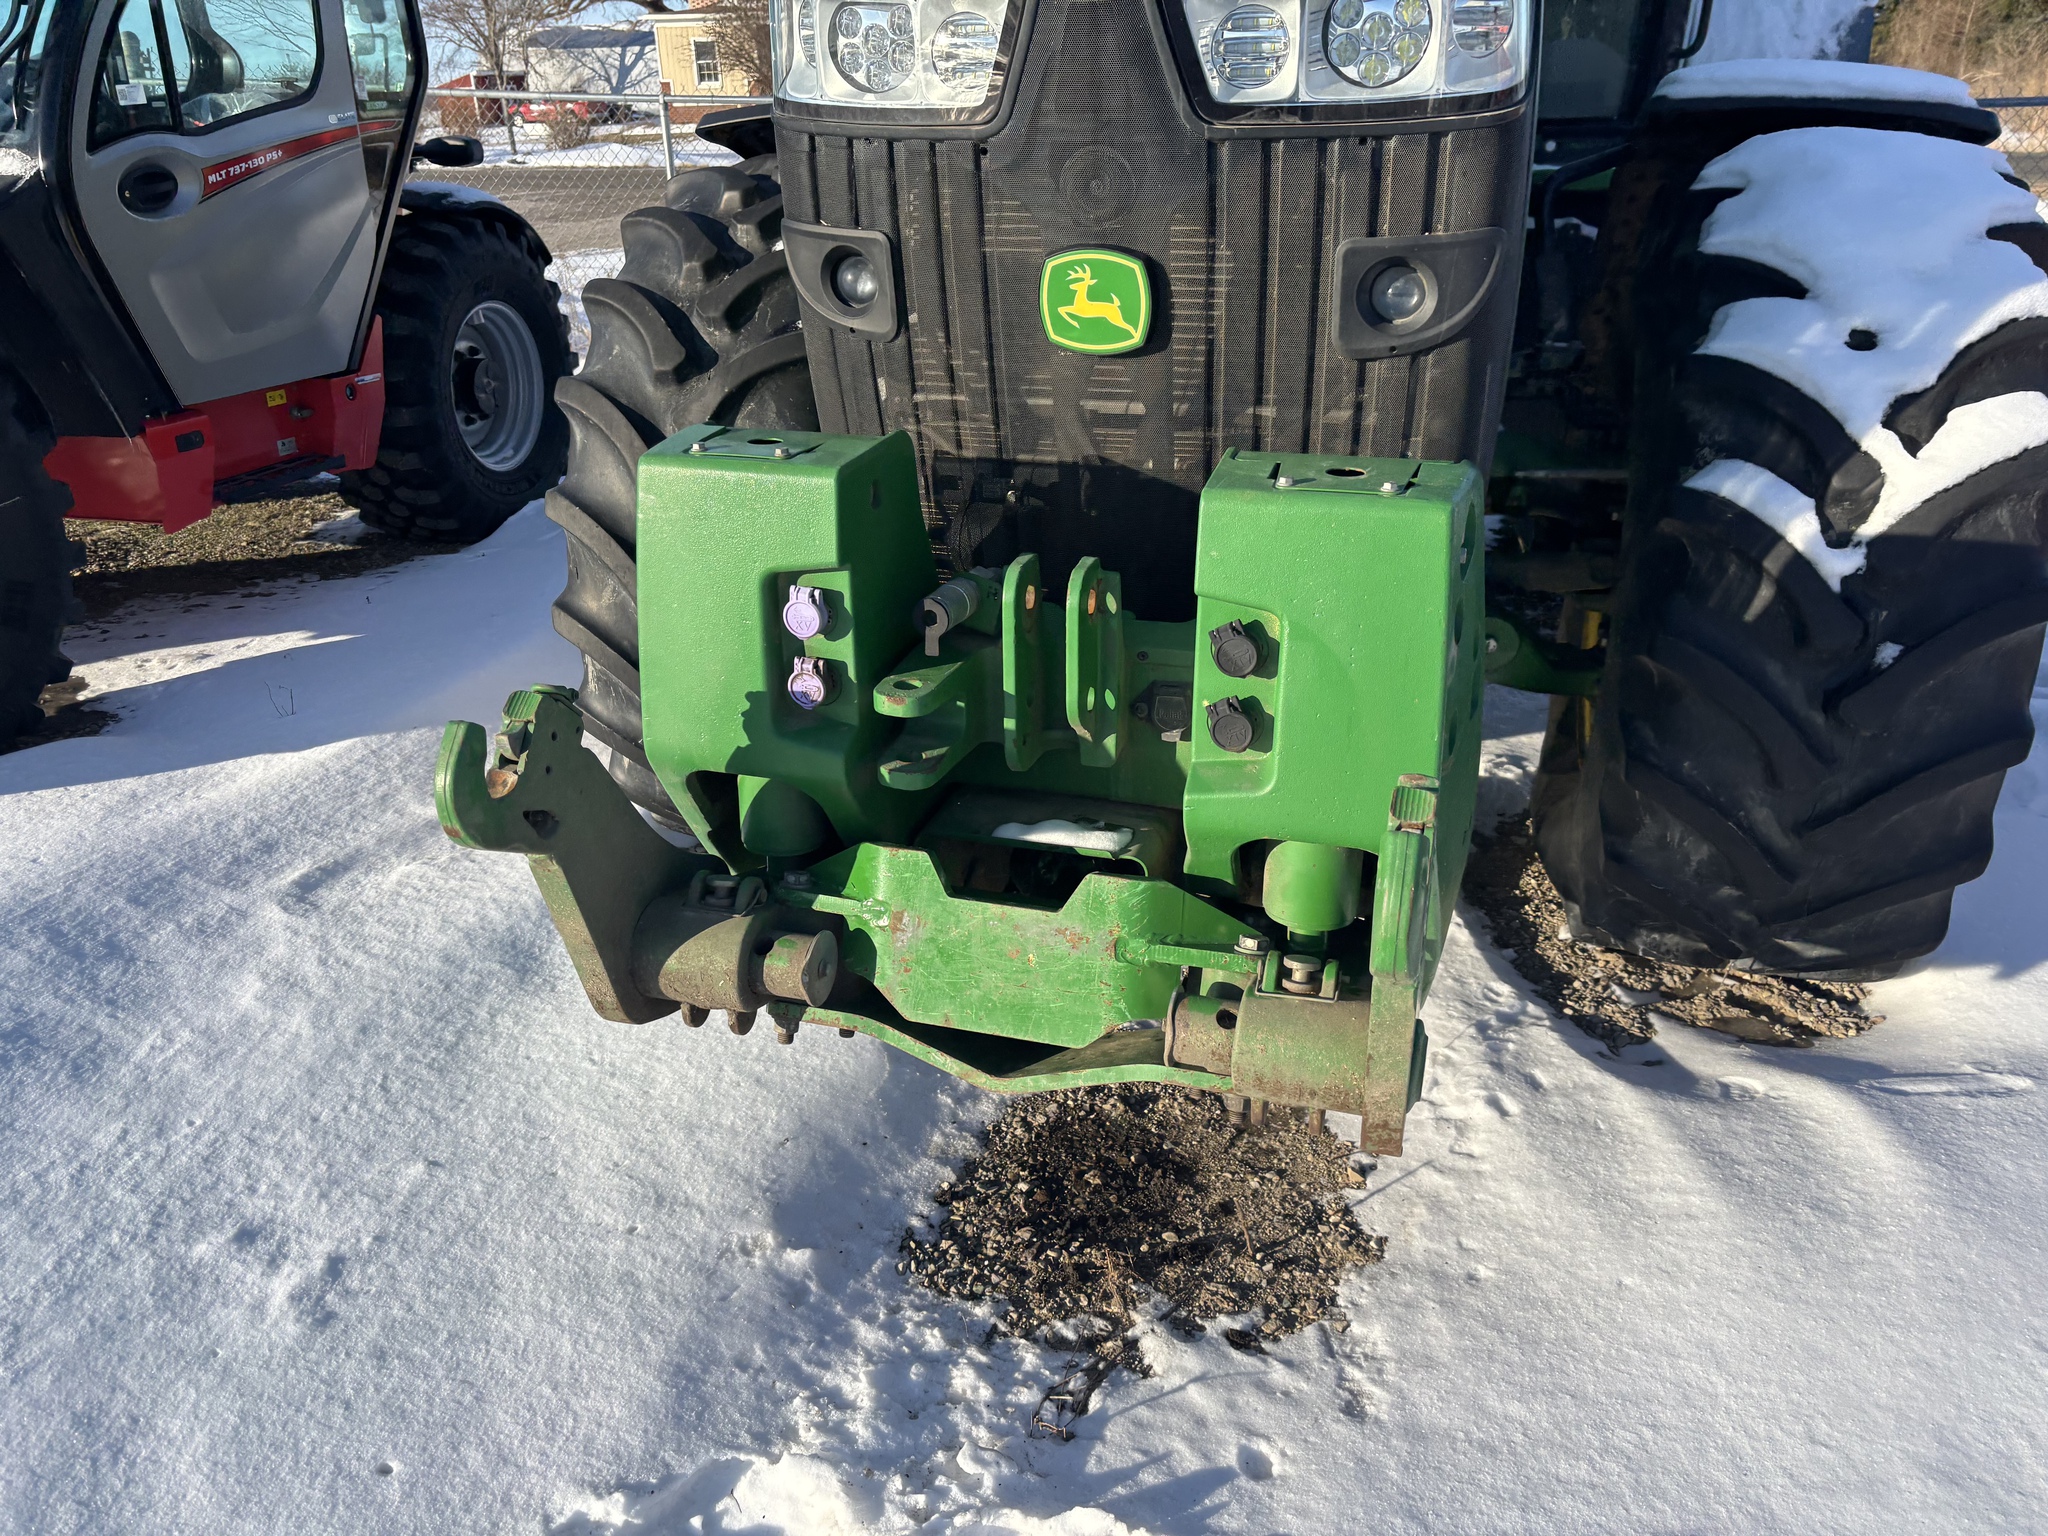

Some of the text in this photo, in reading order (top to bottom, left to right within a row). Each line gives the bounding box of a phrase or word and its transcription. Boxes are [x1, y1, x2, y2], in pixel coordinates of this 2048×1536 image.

[207, 149, 283, 185] MLT 737-130 PS+
